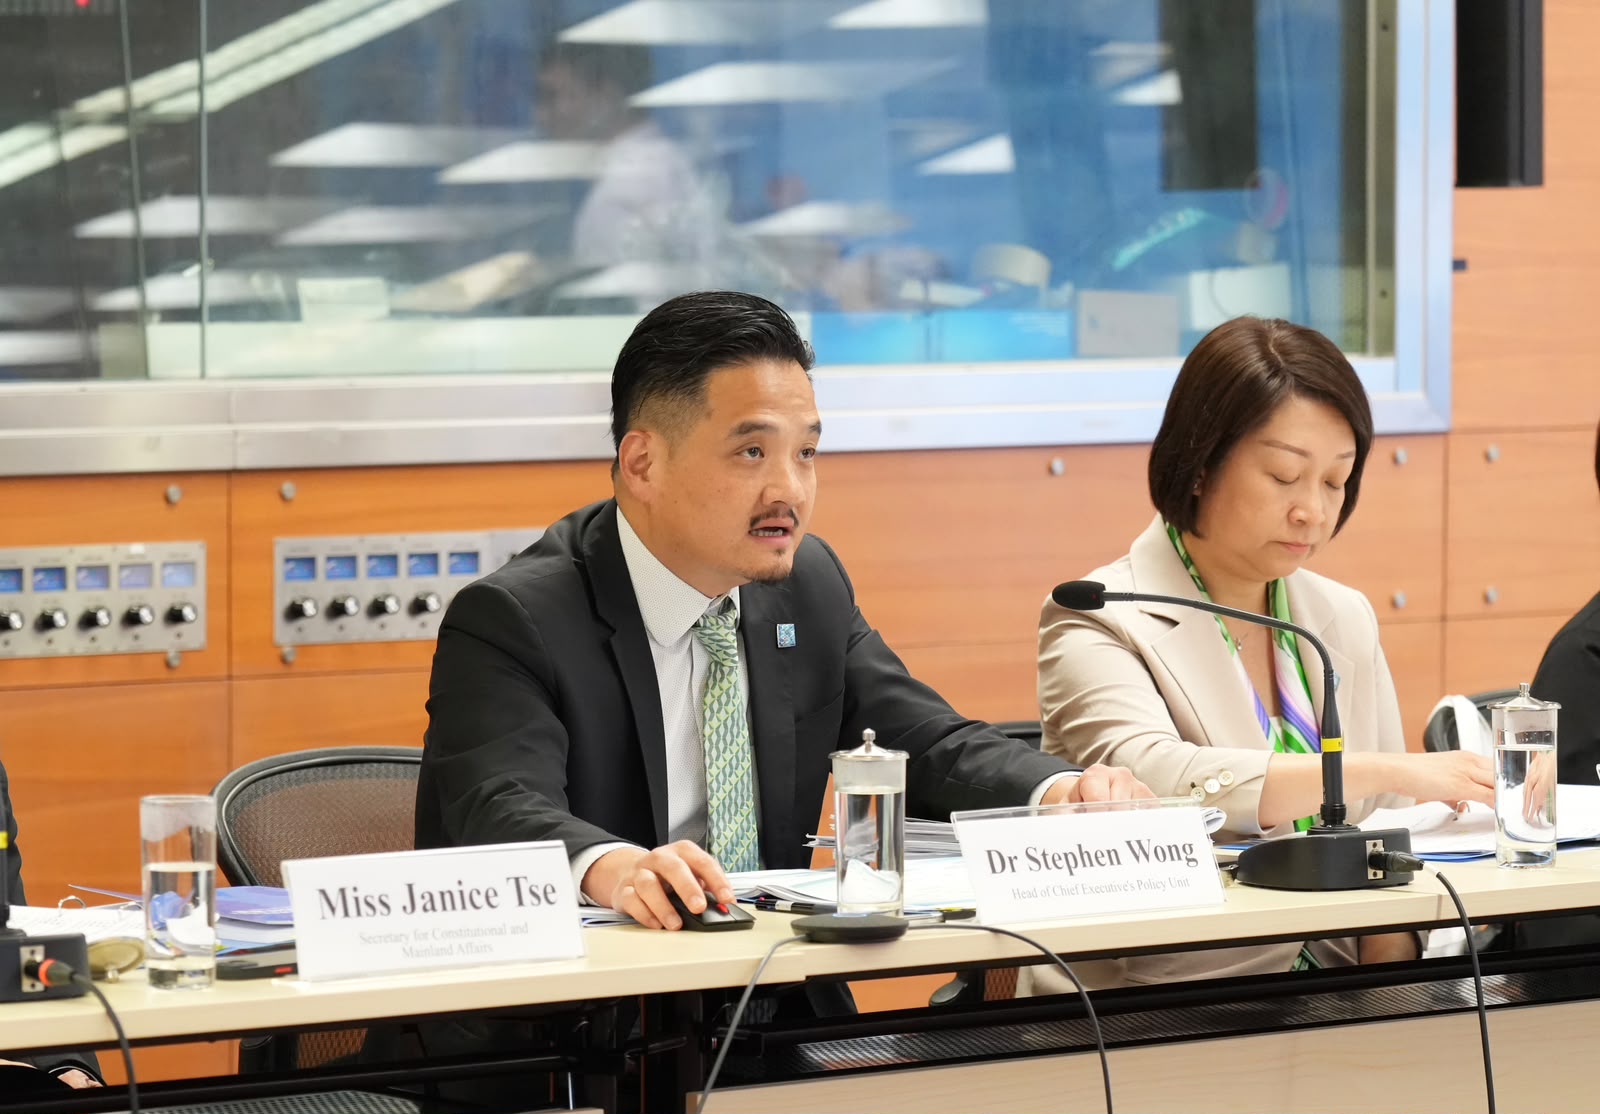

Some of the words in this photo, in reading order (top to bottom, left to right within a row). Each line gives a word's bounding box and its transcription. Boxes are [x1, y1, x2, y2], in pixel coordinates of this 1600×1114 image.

[985, 849, 1018, 874] Dr
[1025, 843, 1122, 876] Stephen
[1125, 839, 1199, 867] Wong
[316, 886, 392, 920] Miss
[402, 880, 499, 916] Janice
[506, 876, 557, 907] Tse
[1011, 888, 1038, 900] Head
[1040, 887, 1051, 897] of
[1052, 884, 1080, 897] Chief
[1082, 880, 1135, 895] Executive's
[1136, 879, 1166, 892] Policy
[1168, 877, 1190, 888] Unit
[359, 931, 410, 947] Secretary
[413, 928, 429, 941] for
[431, 924, 507, 940] Constitutional
[510, 922, 529, 935] and
[401, 945, 454, 960] Mainland
[456, 942, 493, 956] Affairs
